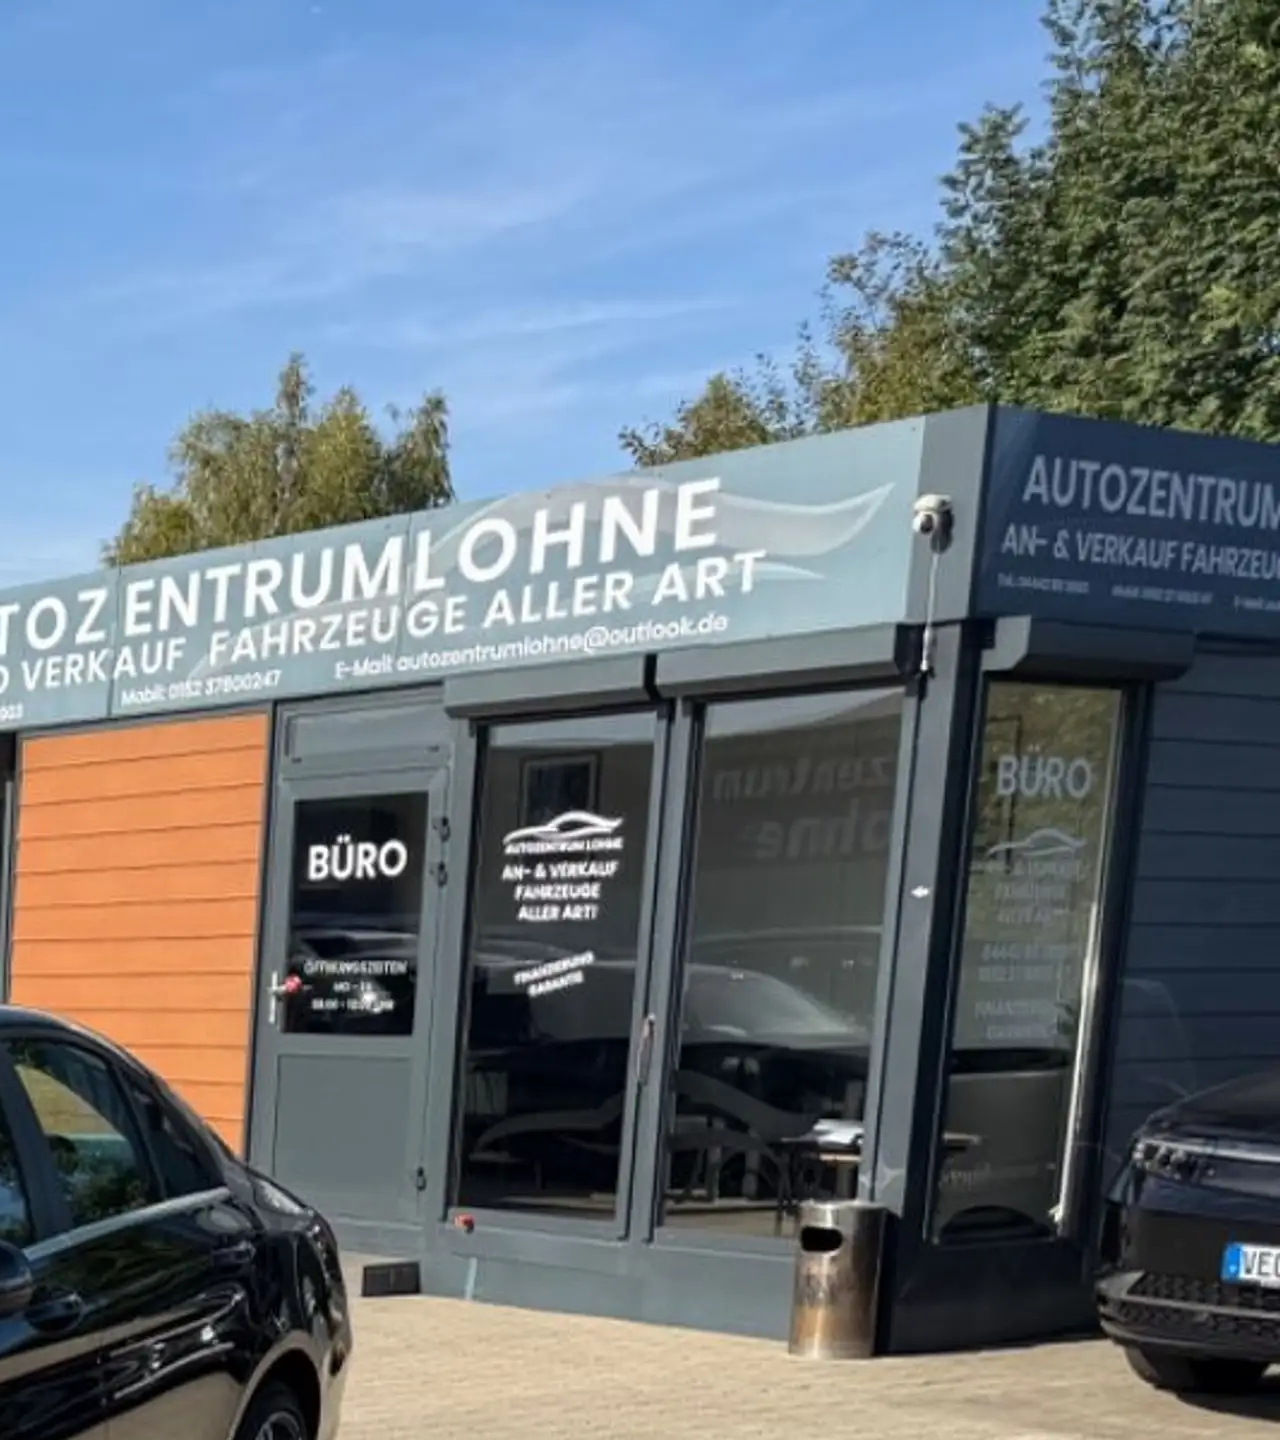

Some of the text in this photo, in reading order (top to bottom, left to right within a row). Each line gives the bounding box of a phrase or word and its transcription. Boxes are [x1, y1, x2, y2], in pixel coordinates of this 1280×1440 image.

[1001, 522, 1280, 581] AN- & VERKAUF FAHRZEU
[22, 635, 186, 692] VERKAUF
[208, 596, 467, 667] FAHRZEUGE
[483, 571, 632, 629] ALLER
[652, 548, 767, 602] ART
[996, 745, 1092, 798] BÜRO
[307, 833, 409, 881] BÜRO
[549, 860, 620, 879] VERKAUF
[514, 882, 601, 901] FAHRZEUGE
[516, 905, 561, 921] ALLER
[1243, 1250, 1280, 1278] VE
